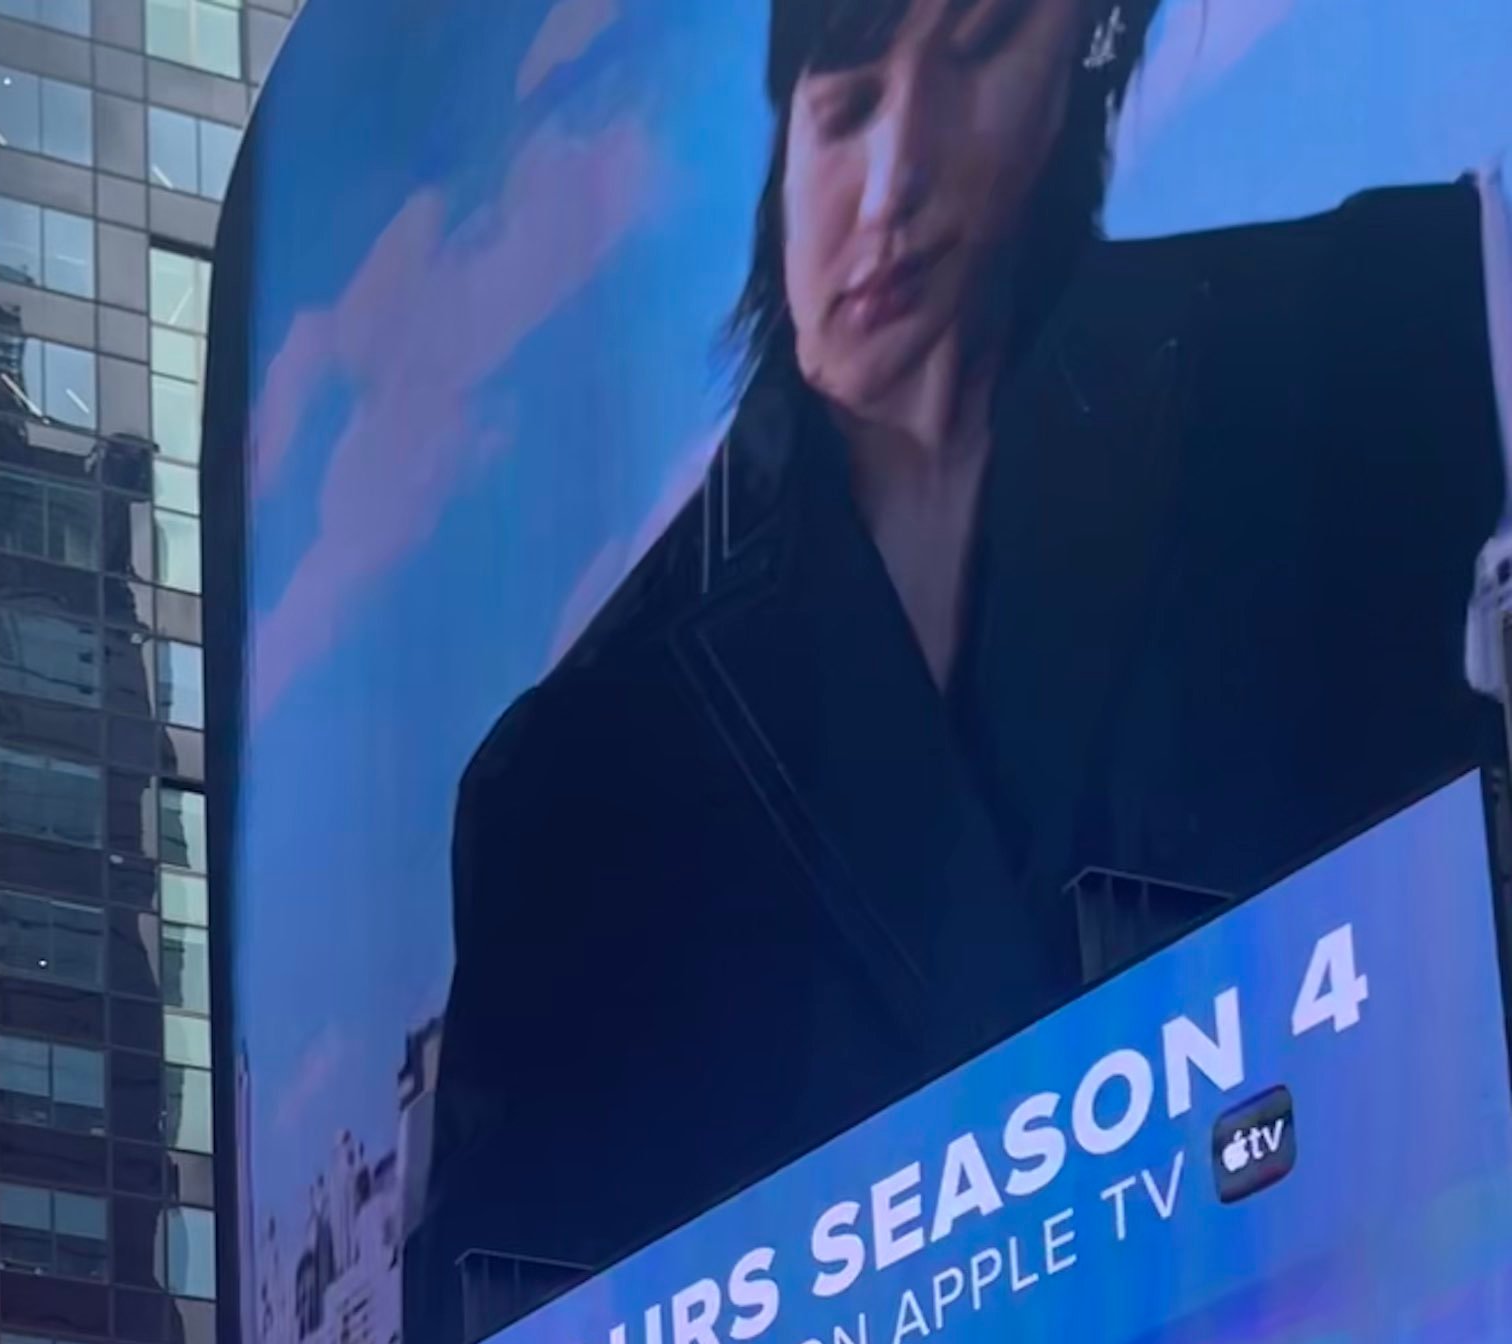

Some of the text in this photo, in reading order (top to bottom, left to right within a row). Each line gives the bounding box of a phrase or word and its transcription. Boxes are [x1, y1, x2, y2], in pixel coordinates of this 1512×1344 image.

[811, 986, 1245, 1297] SEASON
[1292, 923, 1369, 1036] 4
[1100, 1150, 1185, 1241] TV
